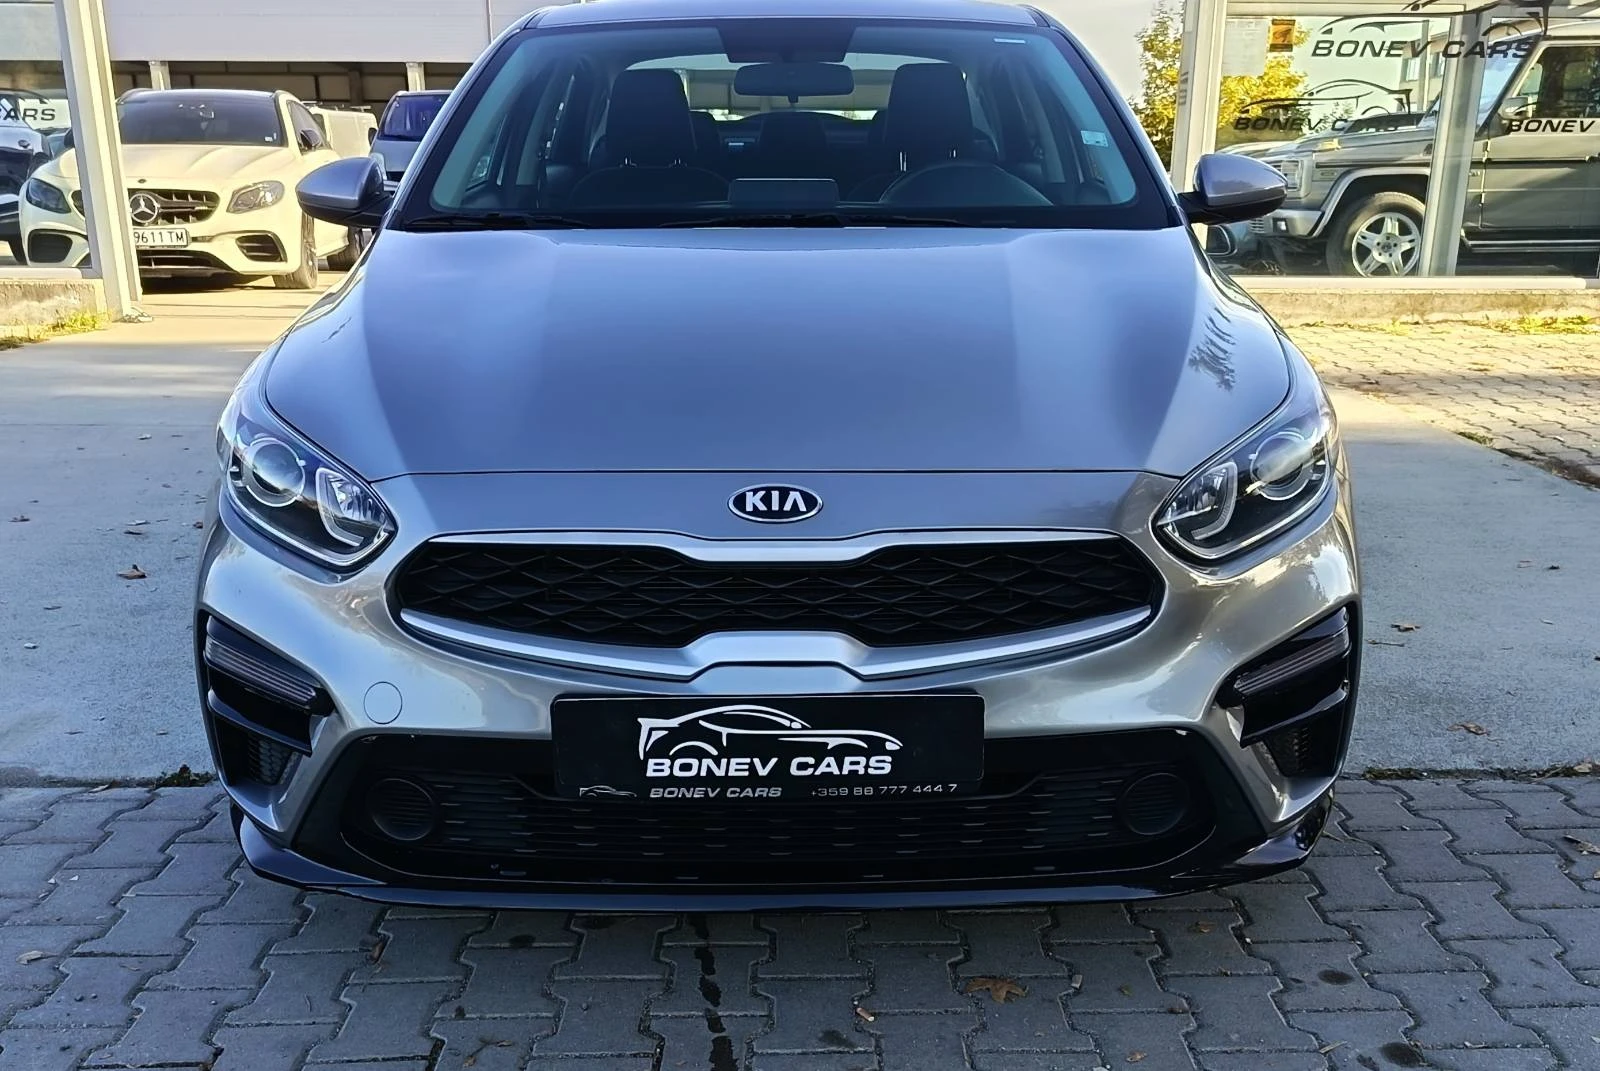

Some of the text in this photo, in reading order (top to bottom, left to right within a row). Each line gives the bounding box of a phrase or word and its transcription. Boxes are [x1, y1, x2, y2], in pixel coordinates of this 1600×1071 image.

[1311, 39, 1534, 59] BONEV CARS
[0, 107, 56, 121] ARS
[1234, 116, 1322, 132] BONEV
[1505, 119, 1596, 133] BONEV
[167, 231, 185, 243] TM
[745, 490, 807, 512] KIA
[646, 755, 893, 777] BONEV CARS
[649, 787, 783, 798] BONEV CARS
[811, 783, 958, 797] +359 88 777 444 7
